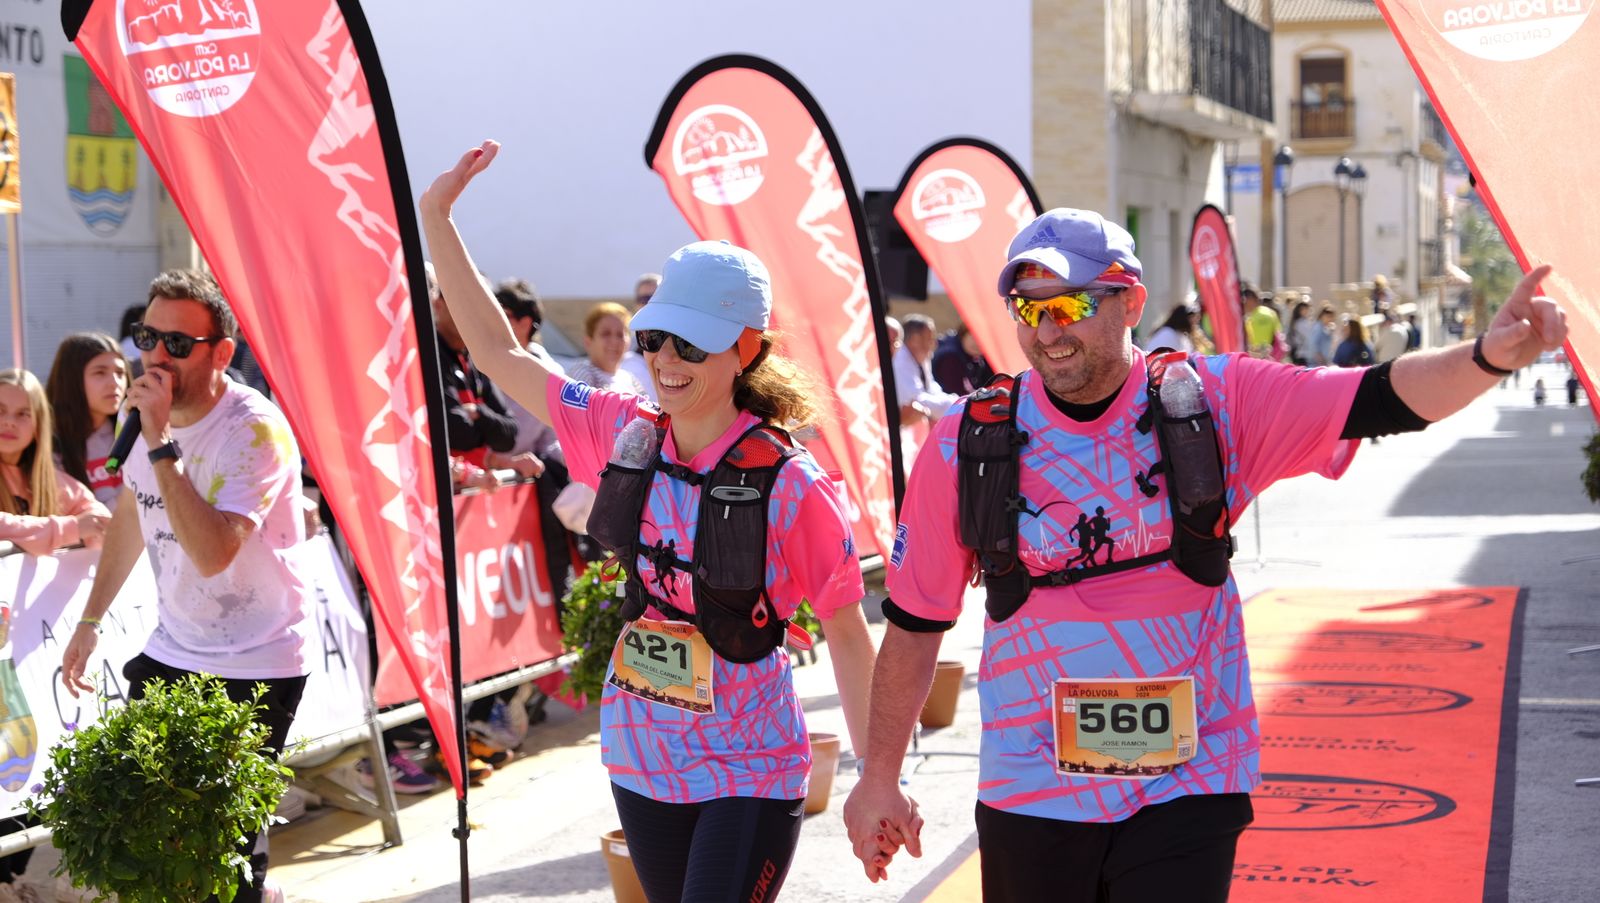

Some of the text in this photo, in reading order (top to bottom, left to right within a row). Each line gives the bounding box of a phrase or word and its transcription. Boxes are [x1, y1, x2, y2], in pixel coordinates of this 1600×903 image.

[624, 630, 688, 670] 421
[649, 666, 660, 674] DEL
[660, 670, 683, 681] CARMEN
[1068, 684, 1167, 698] LA PÓLVORA CANTORIA
[1080, 702, 1170, 734] 560
